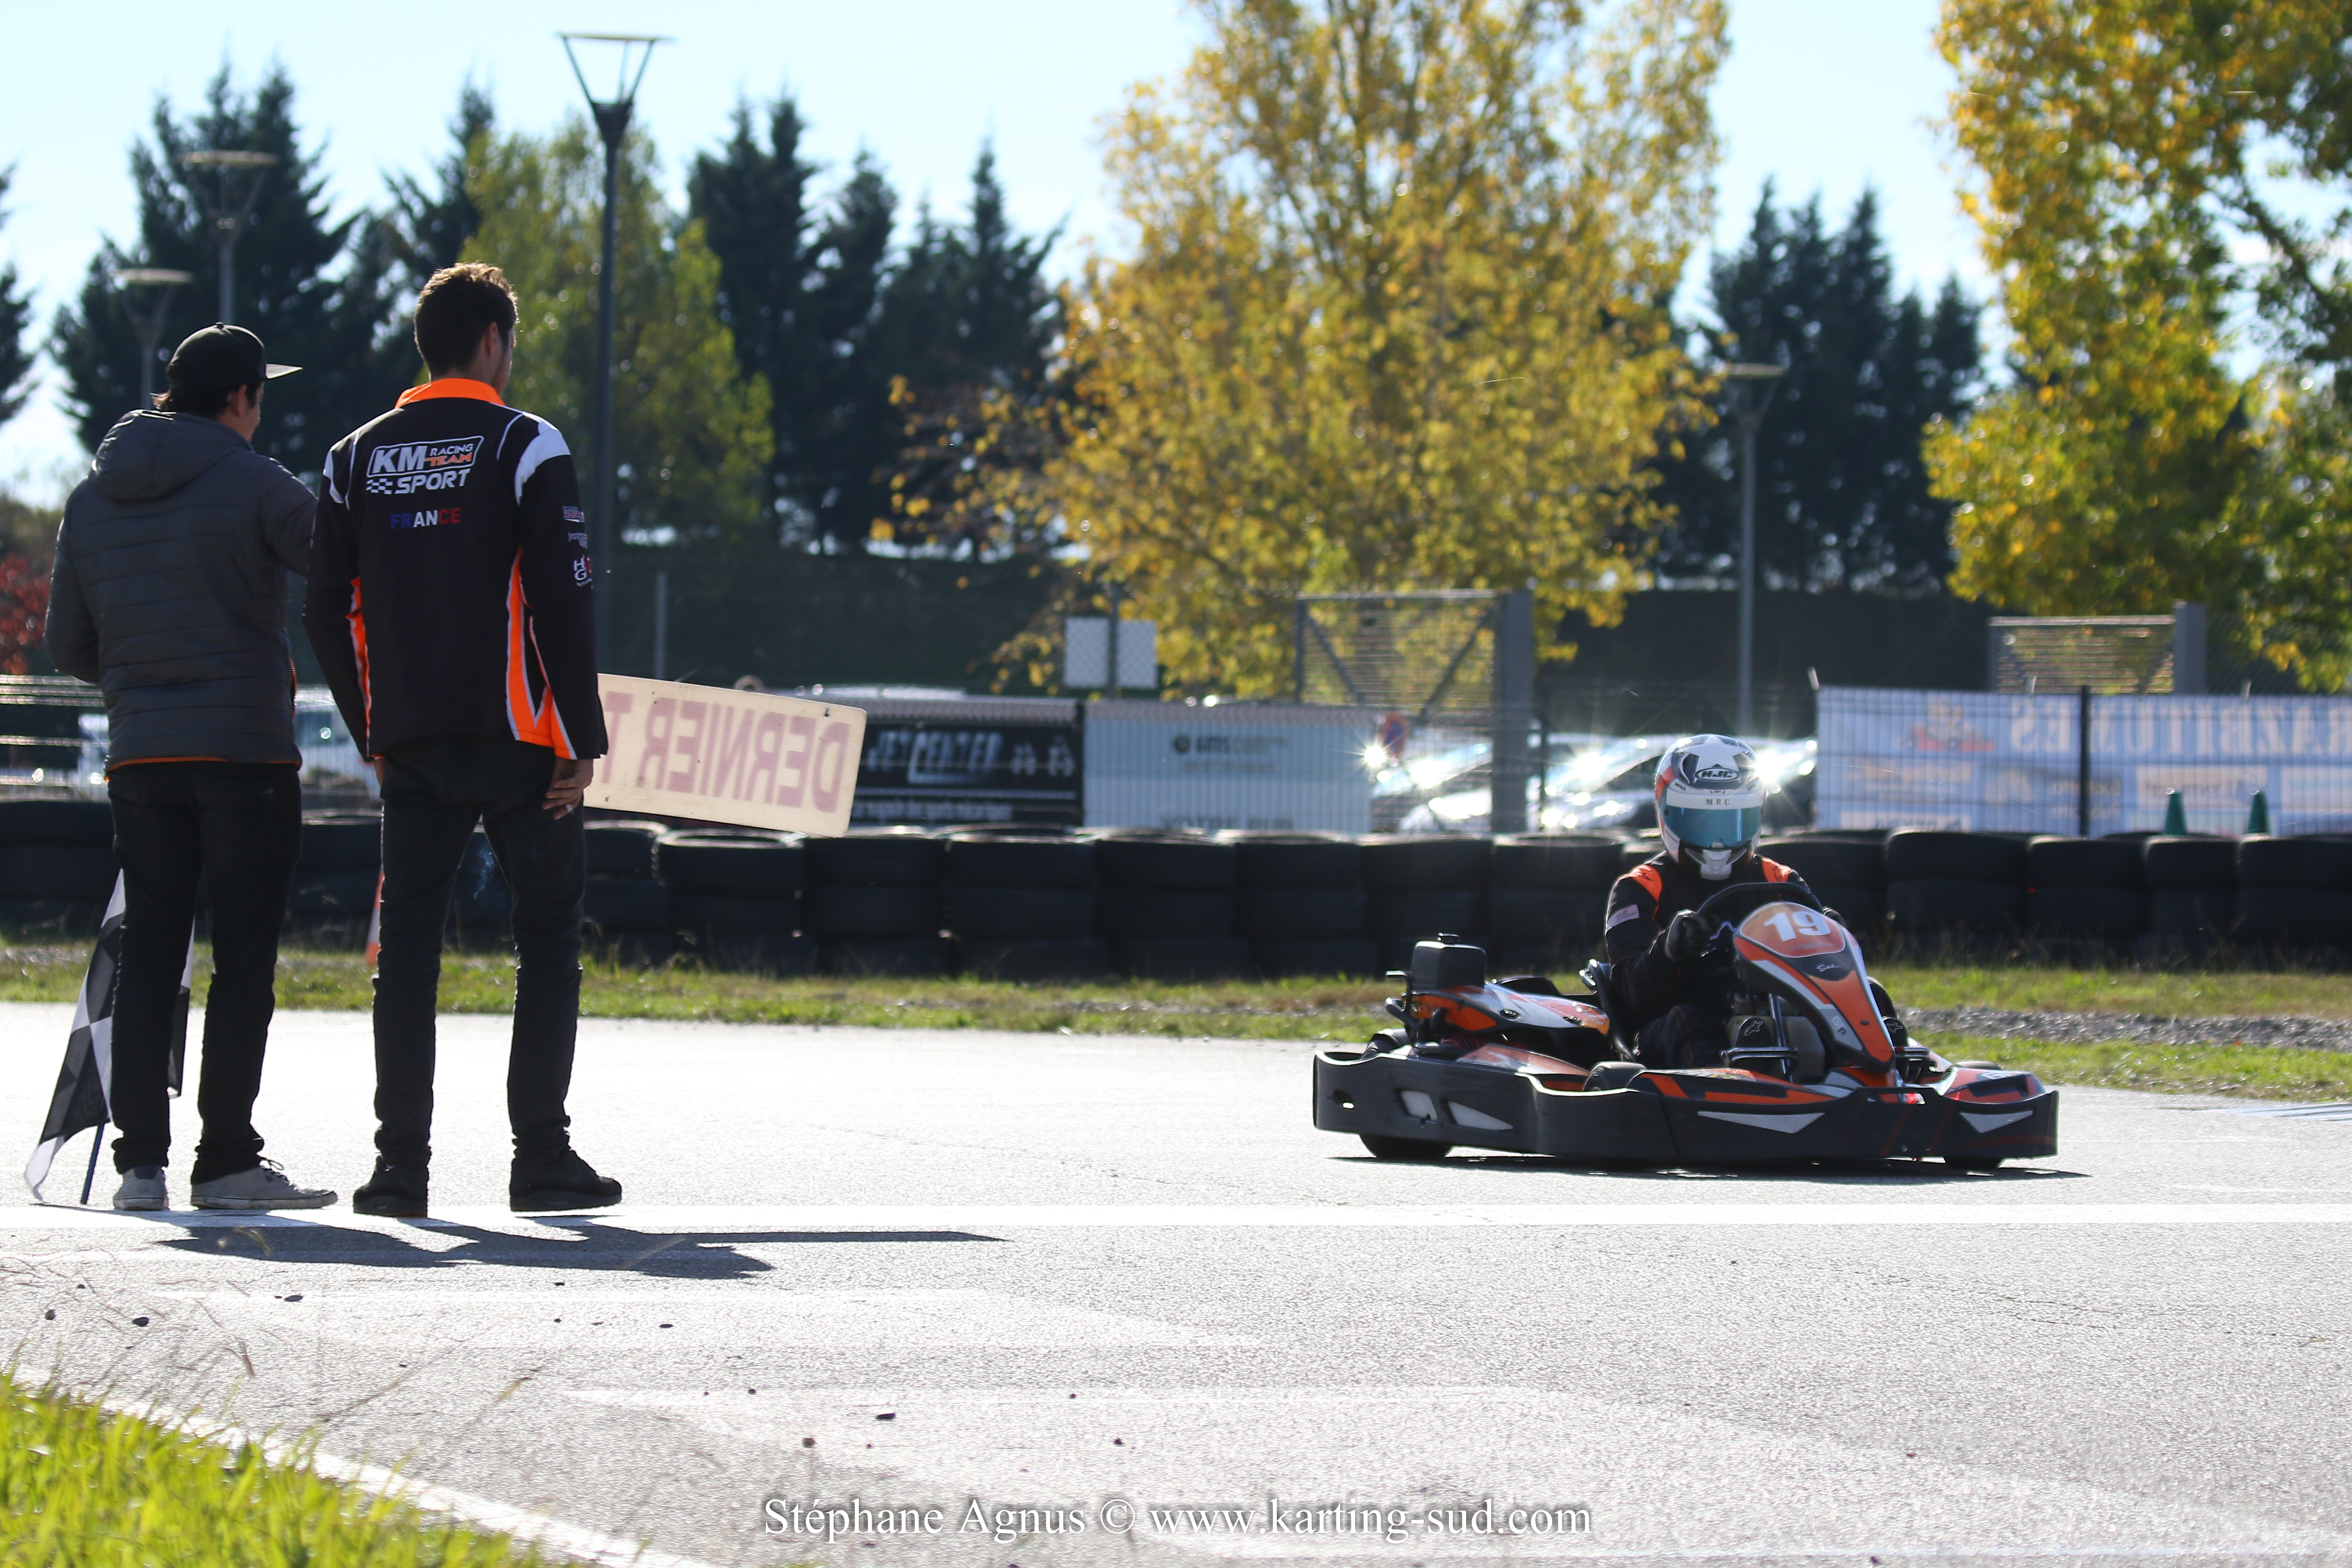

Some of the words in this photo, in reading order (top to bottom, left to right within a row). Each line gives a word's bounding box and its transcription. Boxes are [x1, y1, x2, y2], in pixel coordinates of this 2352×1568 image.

[372, 445, 428, 473] KM
[424, 452, 472, 466] TEAM
[429, 443, 474, 456] RACING
[394, 468, 471, 494] SPORT
[390, 508, 461, 530] FRANCE
[1764, 910, 1831, 943] 19
